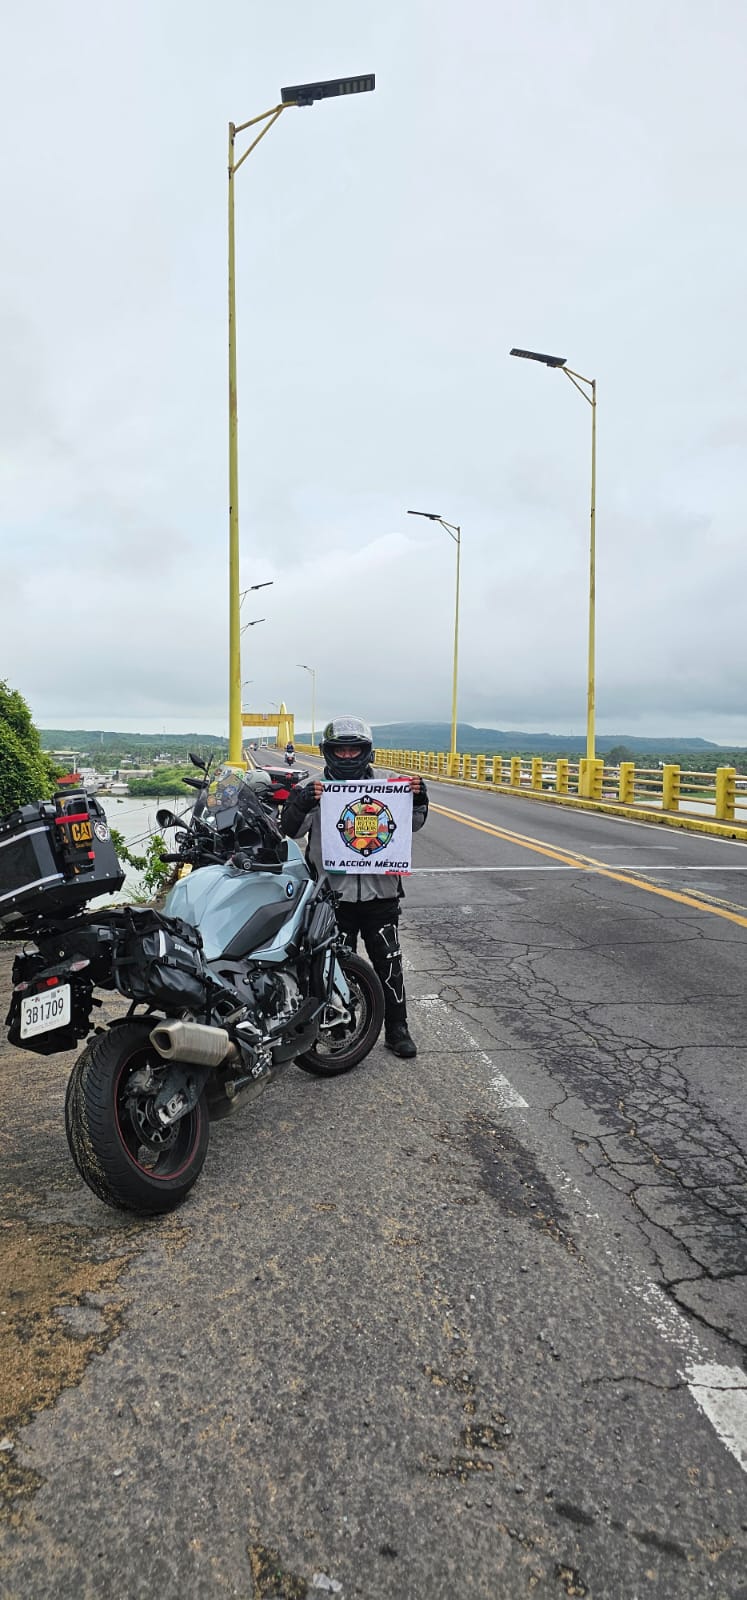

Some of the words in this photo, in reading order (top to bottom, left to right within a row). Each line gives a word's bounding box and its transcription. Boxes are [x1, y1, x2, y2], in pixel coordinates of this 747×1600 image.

[321, 784, 412, 794] MOTOTURISMO
[71, 821, 93, 842] CAT
[339, 858, 372, 867] ACCIÓN
[375, 858, 409, 868] MÉXICO
[25, 997, 64, 1025] 3B1709
